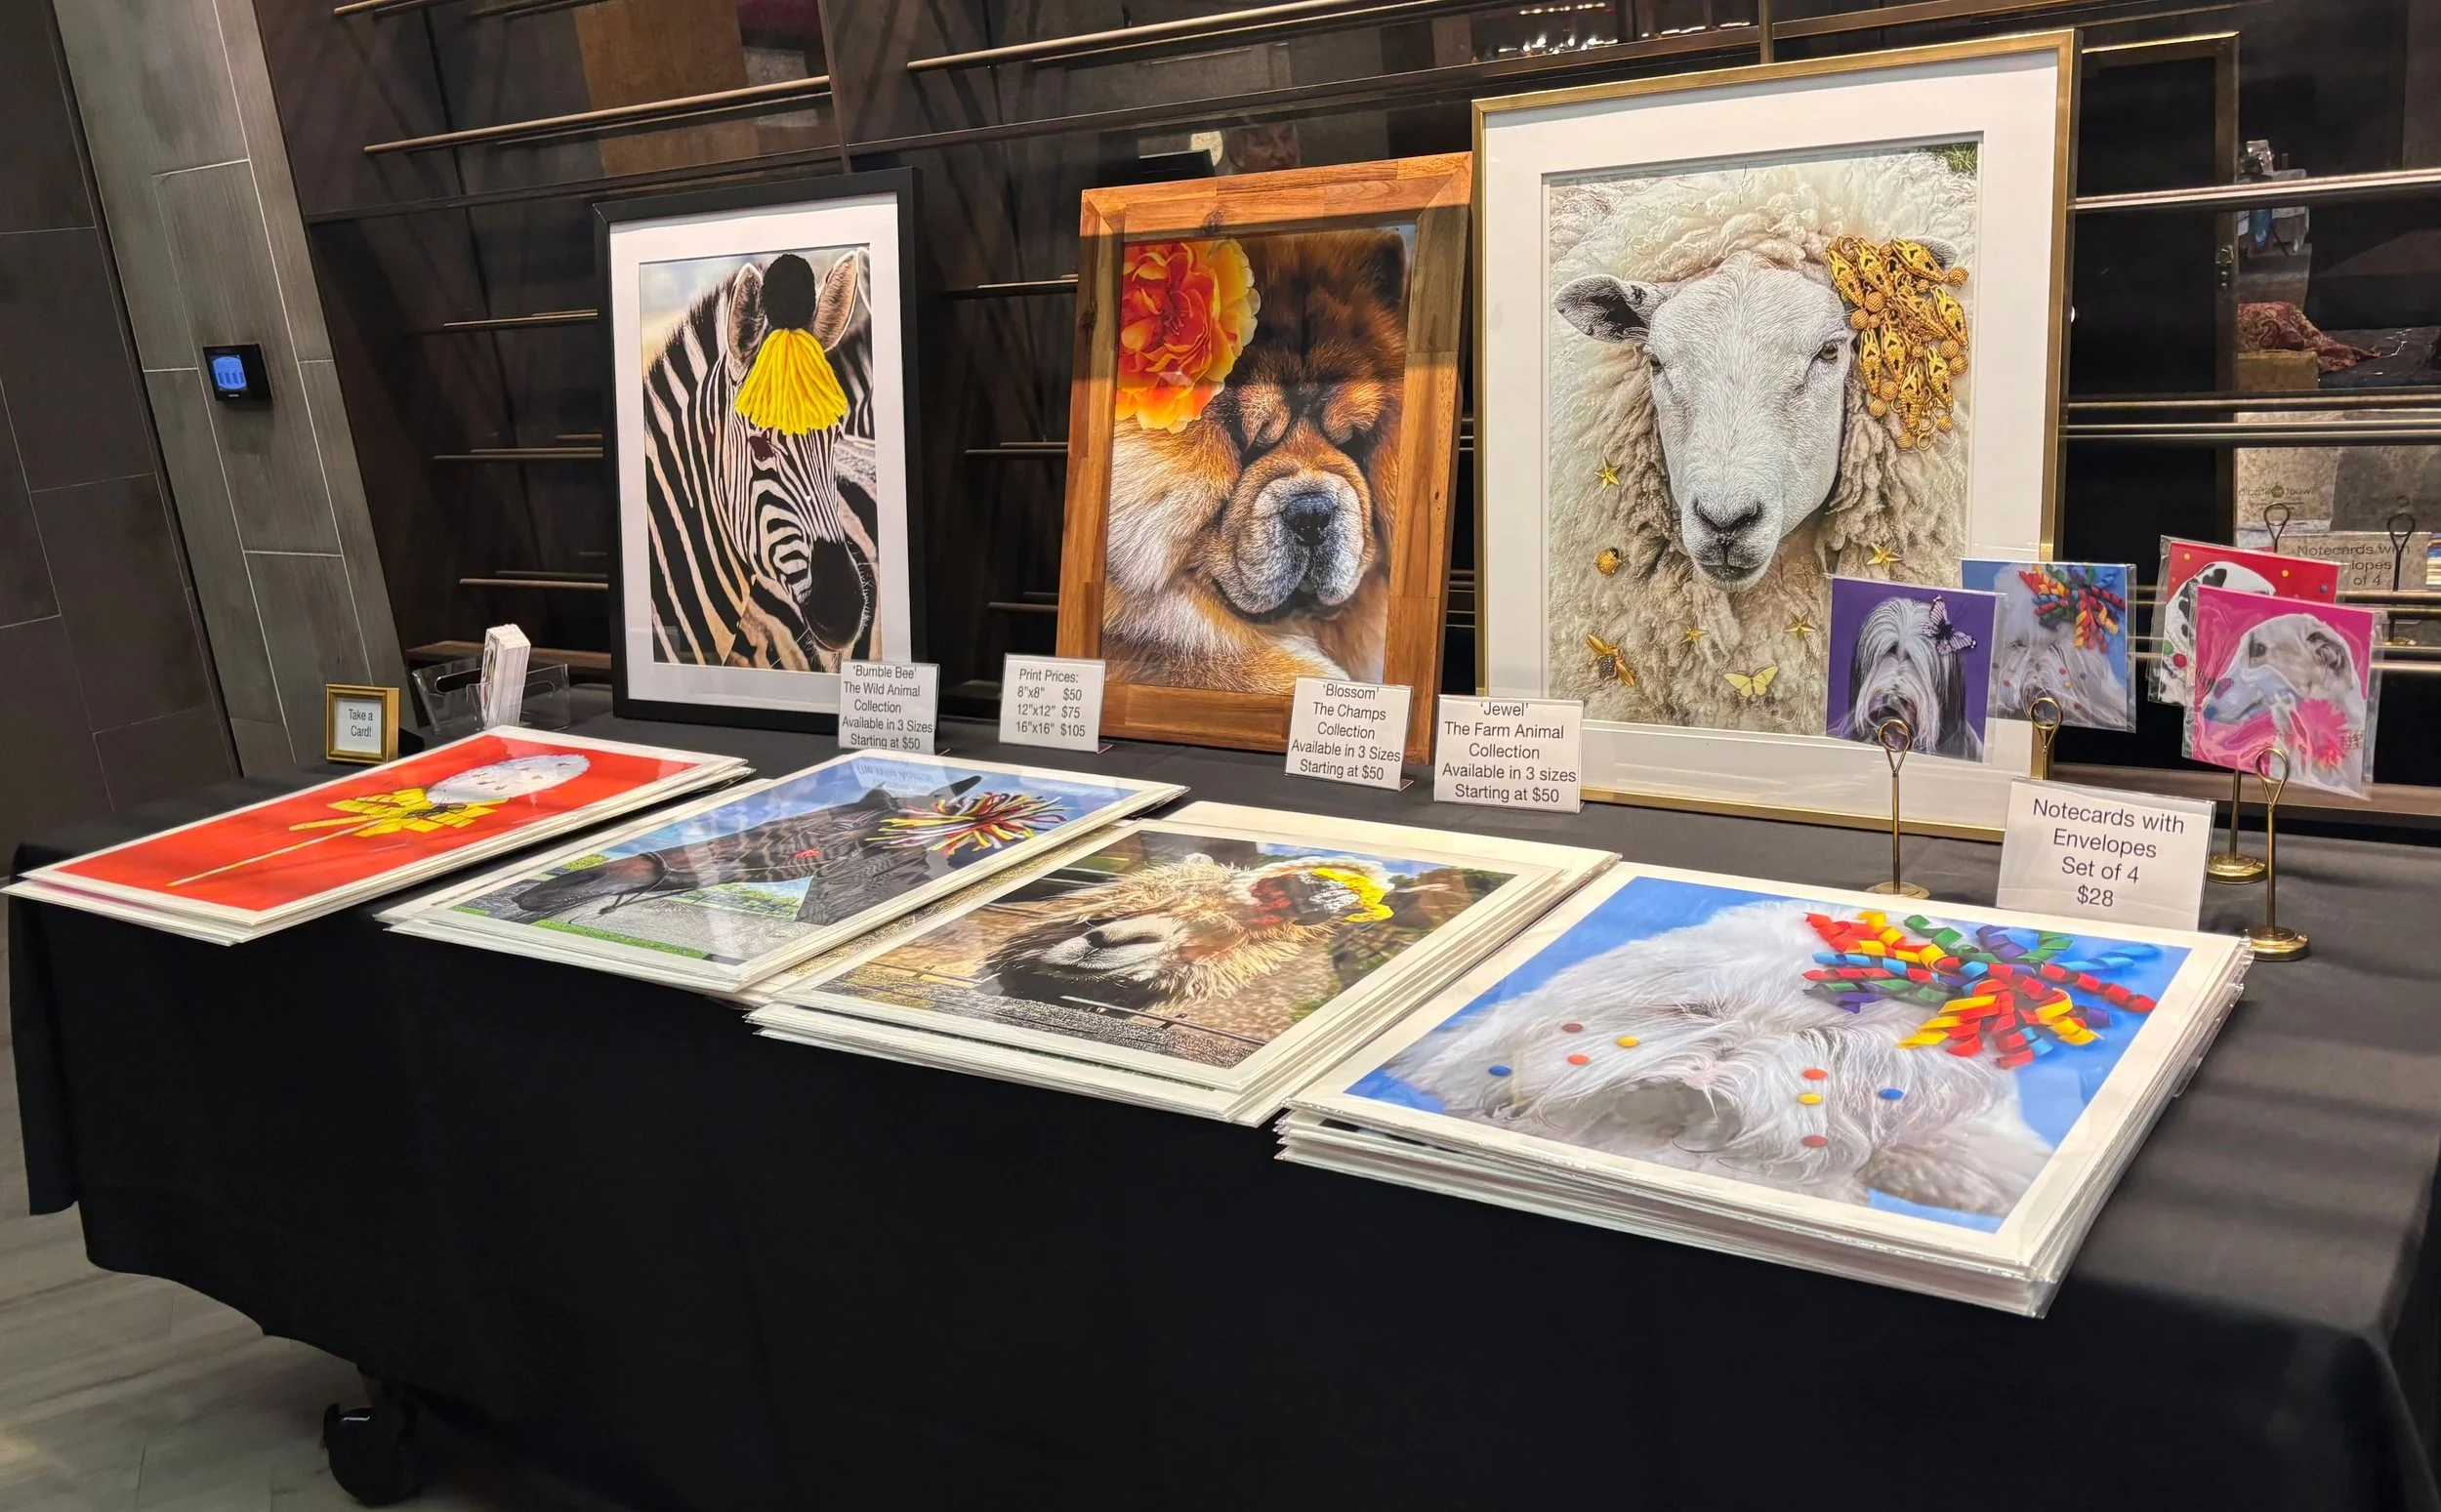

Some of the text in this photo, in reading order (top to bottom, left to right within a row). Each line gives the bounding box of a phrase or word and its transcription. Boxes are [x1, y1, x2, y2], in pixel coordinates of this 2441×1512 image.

[2296, 545, 2374, 556] Notecards
[2373, 575, 2380, 586] 4
[1019, 669, 1079, 683] Print Prices:
[844, 682, 920, 697] The Wild Animal
[1063, 688, 1082, 702] $50
[349, 709, 373, 721] Take a
[854, 699, 901, 714] Collection
[1061, 705, 1080, 719] $75
[1313, 702, 1386, 721] The Champs
[351, 725, 372, 737] Card!
[842, 715, 933, 734] Available in 3 Sizes
[1060, 723, 1085, 737] $105
[1317, 721, 1376, 740] Collection
[1445, 721, 1564, 740] The Farm Animal
[850, 733, 920, 751] Starting at $50
[1291, 738, 1401, 762] Available in 3 Sizes
[1469, 743, 1540, 759] Collection
[1300, 758, 1384, 781] Starting at $50
[1442, 763, 1577, 783] Available in 3 sizes
[1455, 784, 1559, 803] Starting at $50
[2033, 798, 2184, 835] Notecards with
[2053, 828, 2157, 858] Envelopes
[2061, 856, 2139, 883] Set of 4
[2077, 884, 2114, 908] $28
